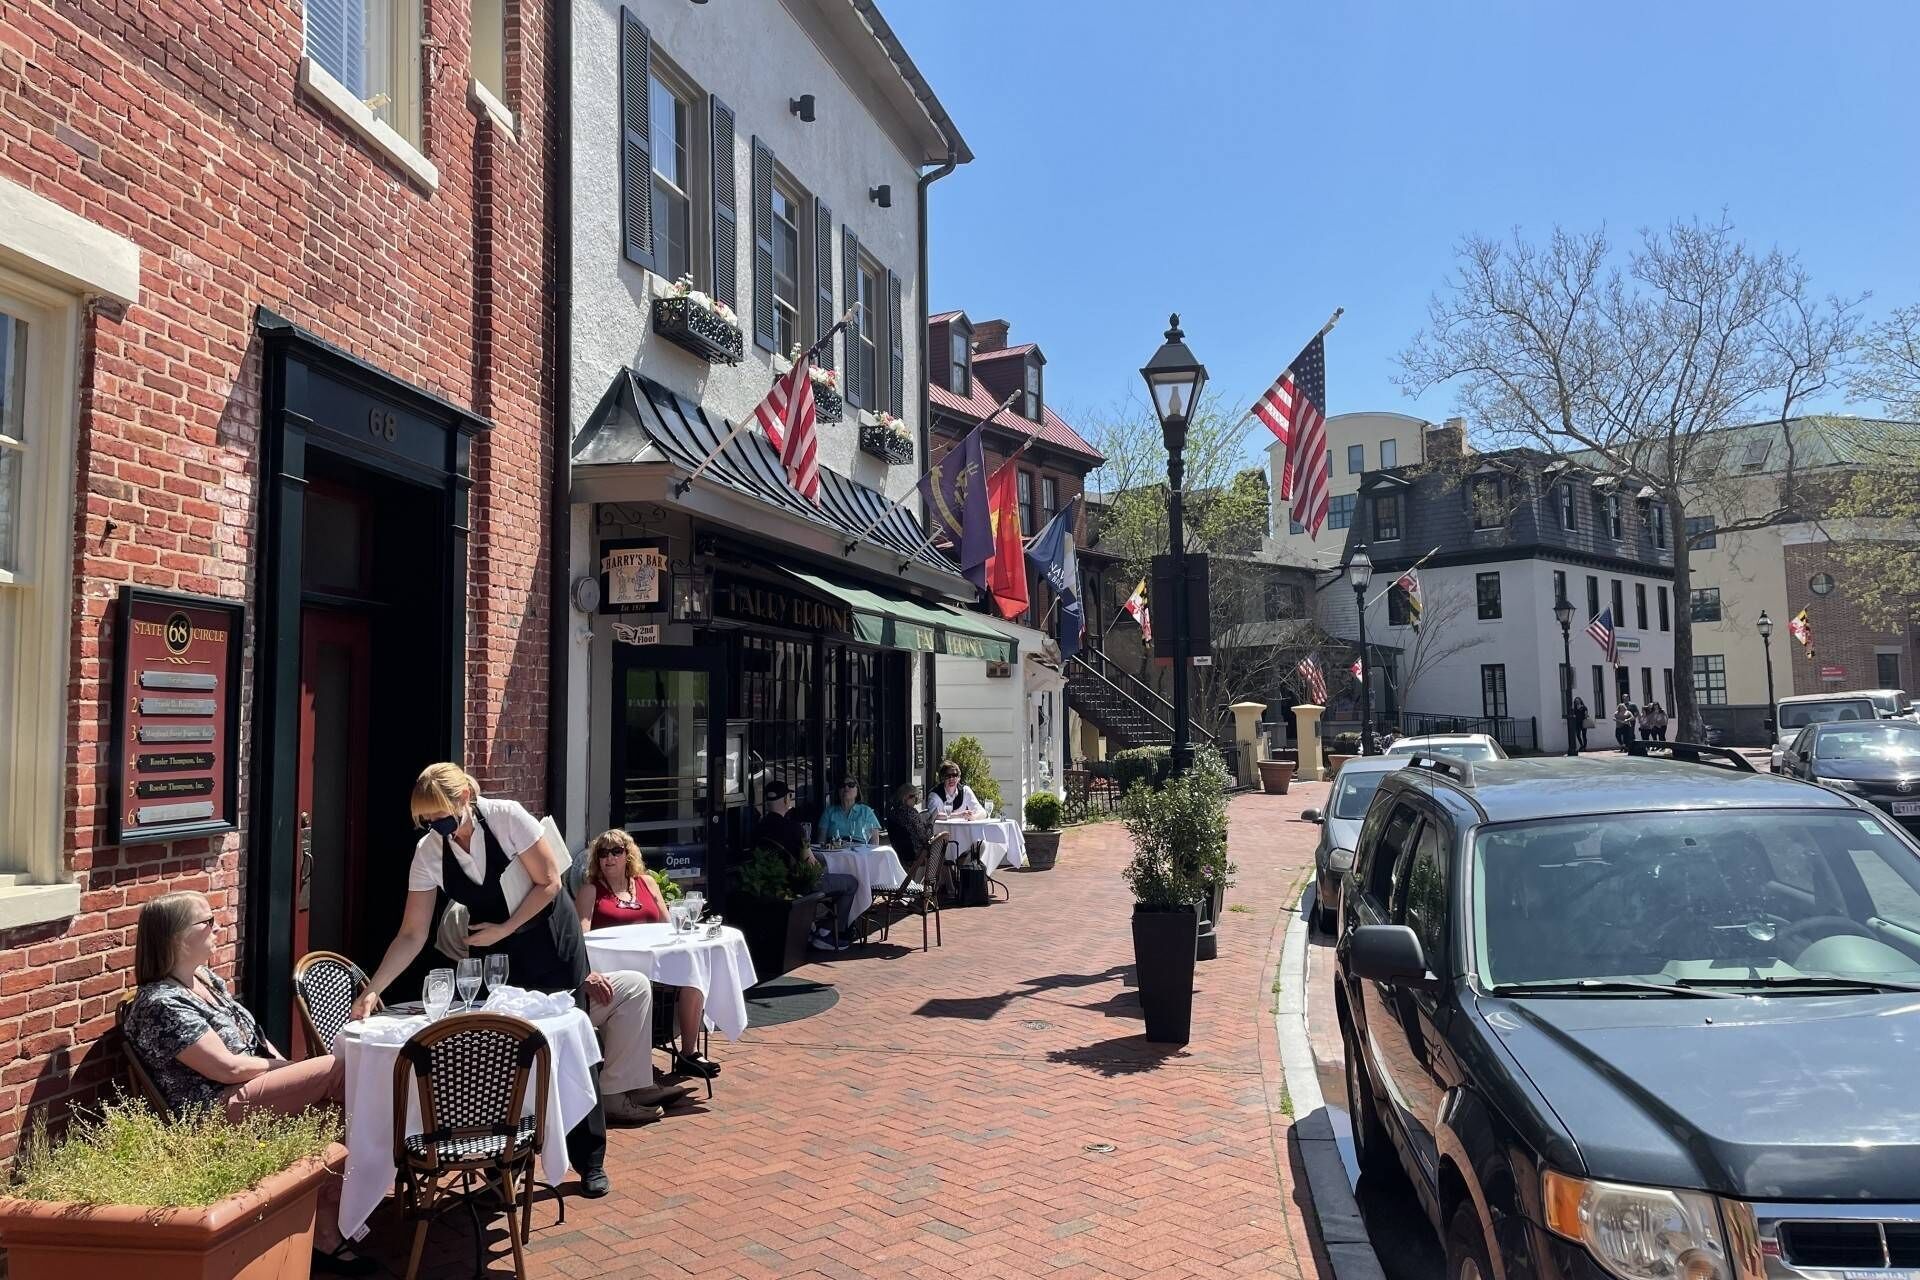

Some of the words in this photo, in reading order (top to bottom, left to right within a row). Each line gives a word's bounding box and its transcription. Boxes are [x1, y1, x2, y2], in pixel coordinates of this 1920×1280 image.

[369, 408, 397, 442] 68
[606, 553, 643, 569] HARRY'S
[646, 552, 663, 568] BAR
[134, 622, 162, 637] STATE
[168, 620, 188, 644] 68
[193, 628, 225, 642] CIRCLE
[640, 626, 654, 634] 2nd
[637, 635, 656, 643] Floor
[132, 670, 138, 686] 1
[131, 697, 138, 713] 2
[130, 725, 137, 741] 3
[129, 753, 136, 770] 4
[128, 780, 135, 798] 5
[127, 808, 135, 826] 6
[666, 856, 690, 868] Open
